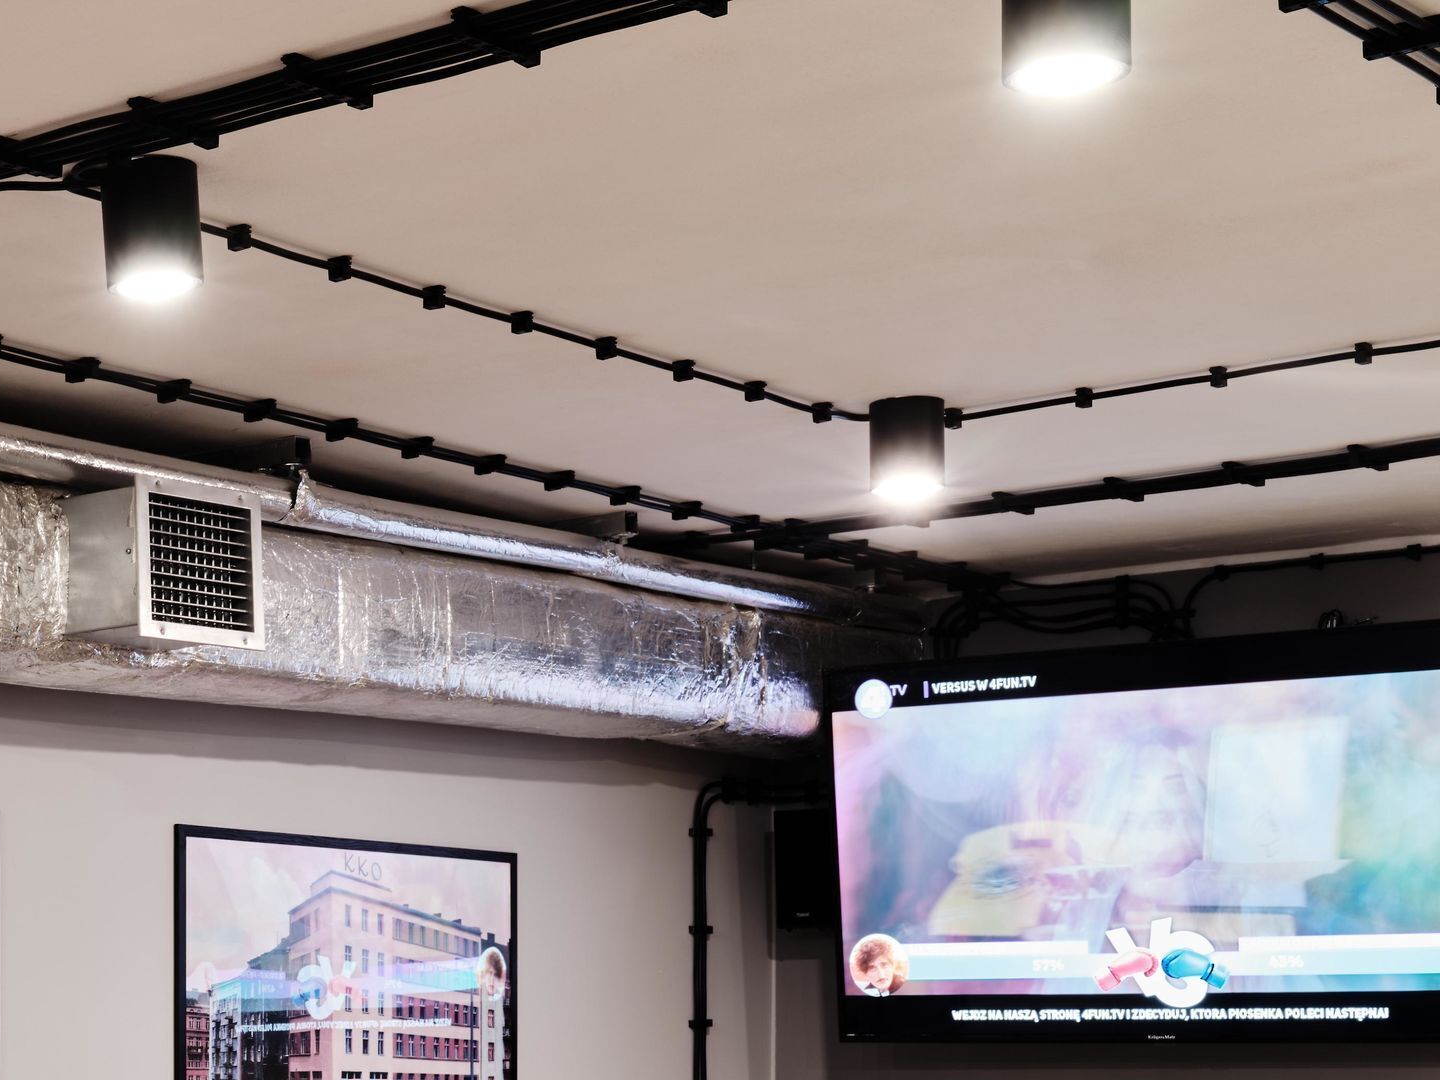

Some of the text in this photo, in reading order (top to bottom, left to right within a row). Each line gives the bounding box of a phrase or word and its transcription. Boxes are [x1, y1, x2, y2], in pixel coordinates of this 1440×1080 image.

[931, 675, 1038, 695] VERSUS W 4FUN.TV
[344, 851, 382, 881] KKO
[987, 1009, 1003, 1020] NA
[1228, 1008, 1284, 1020] PIOSENKA
[1284, 1007, 1324, 1020] POLECI
